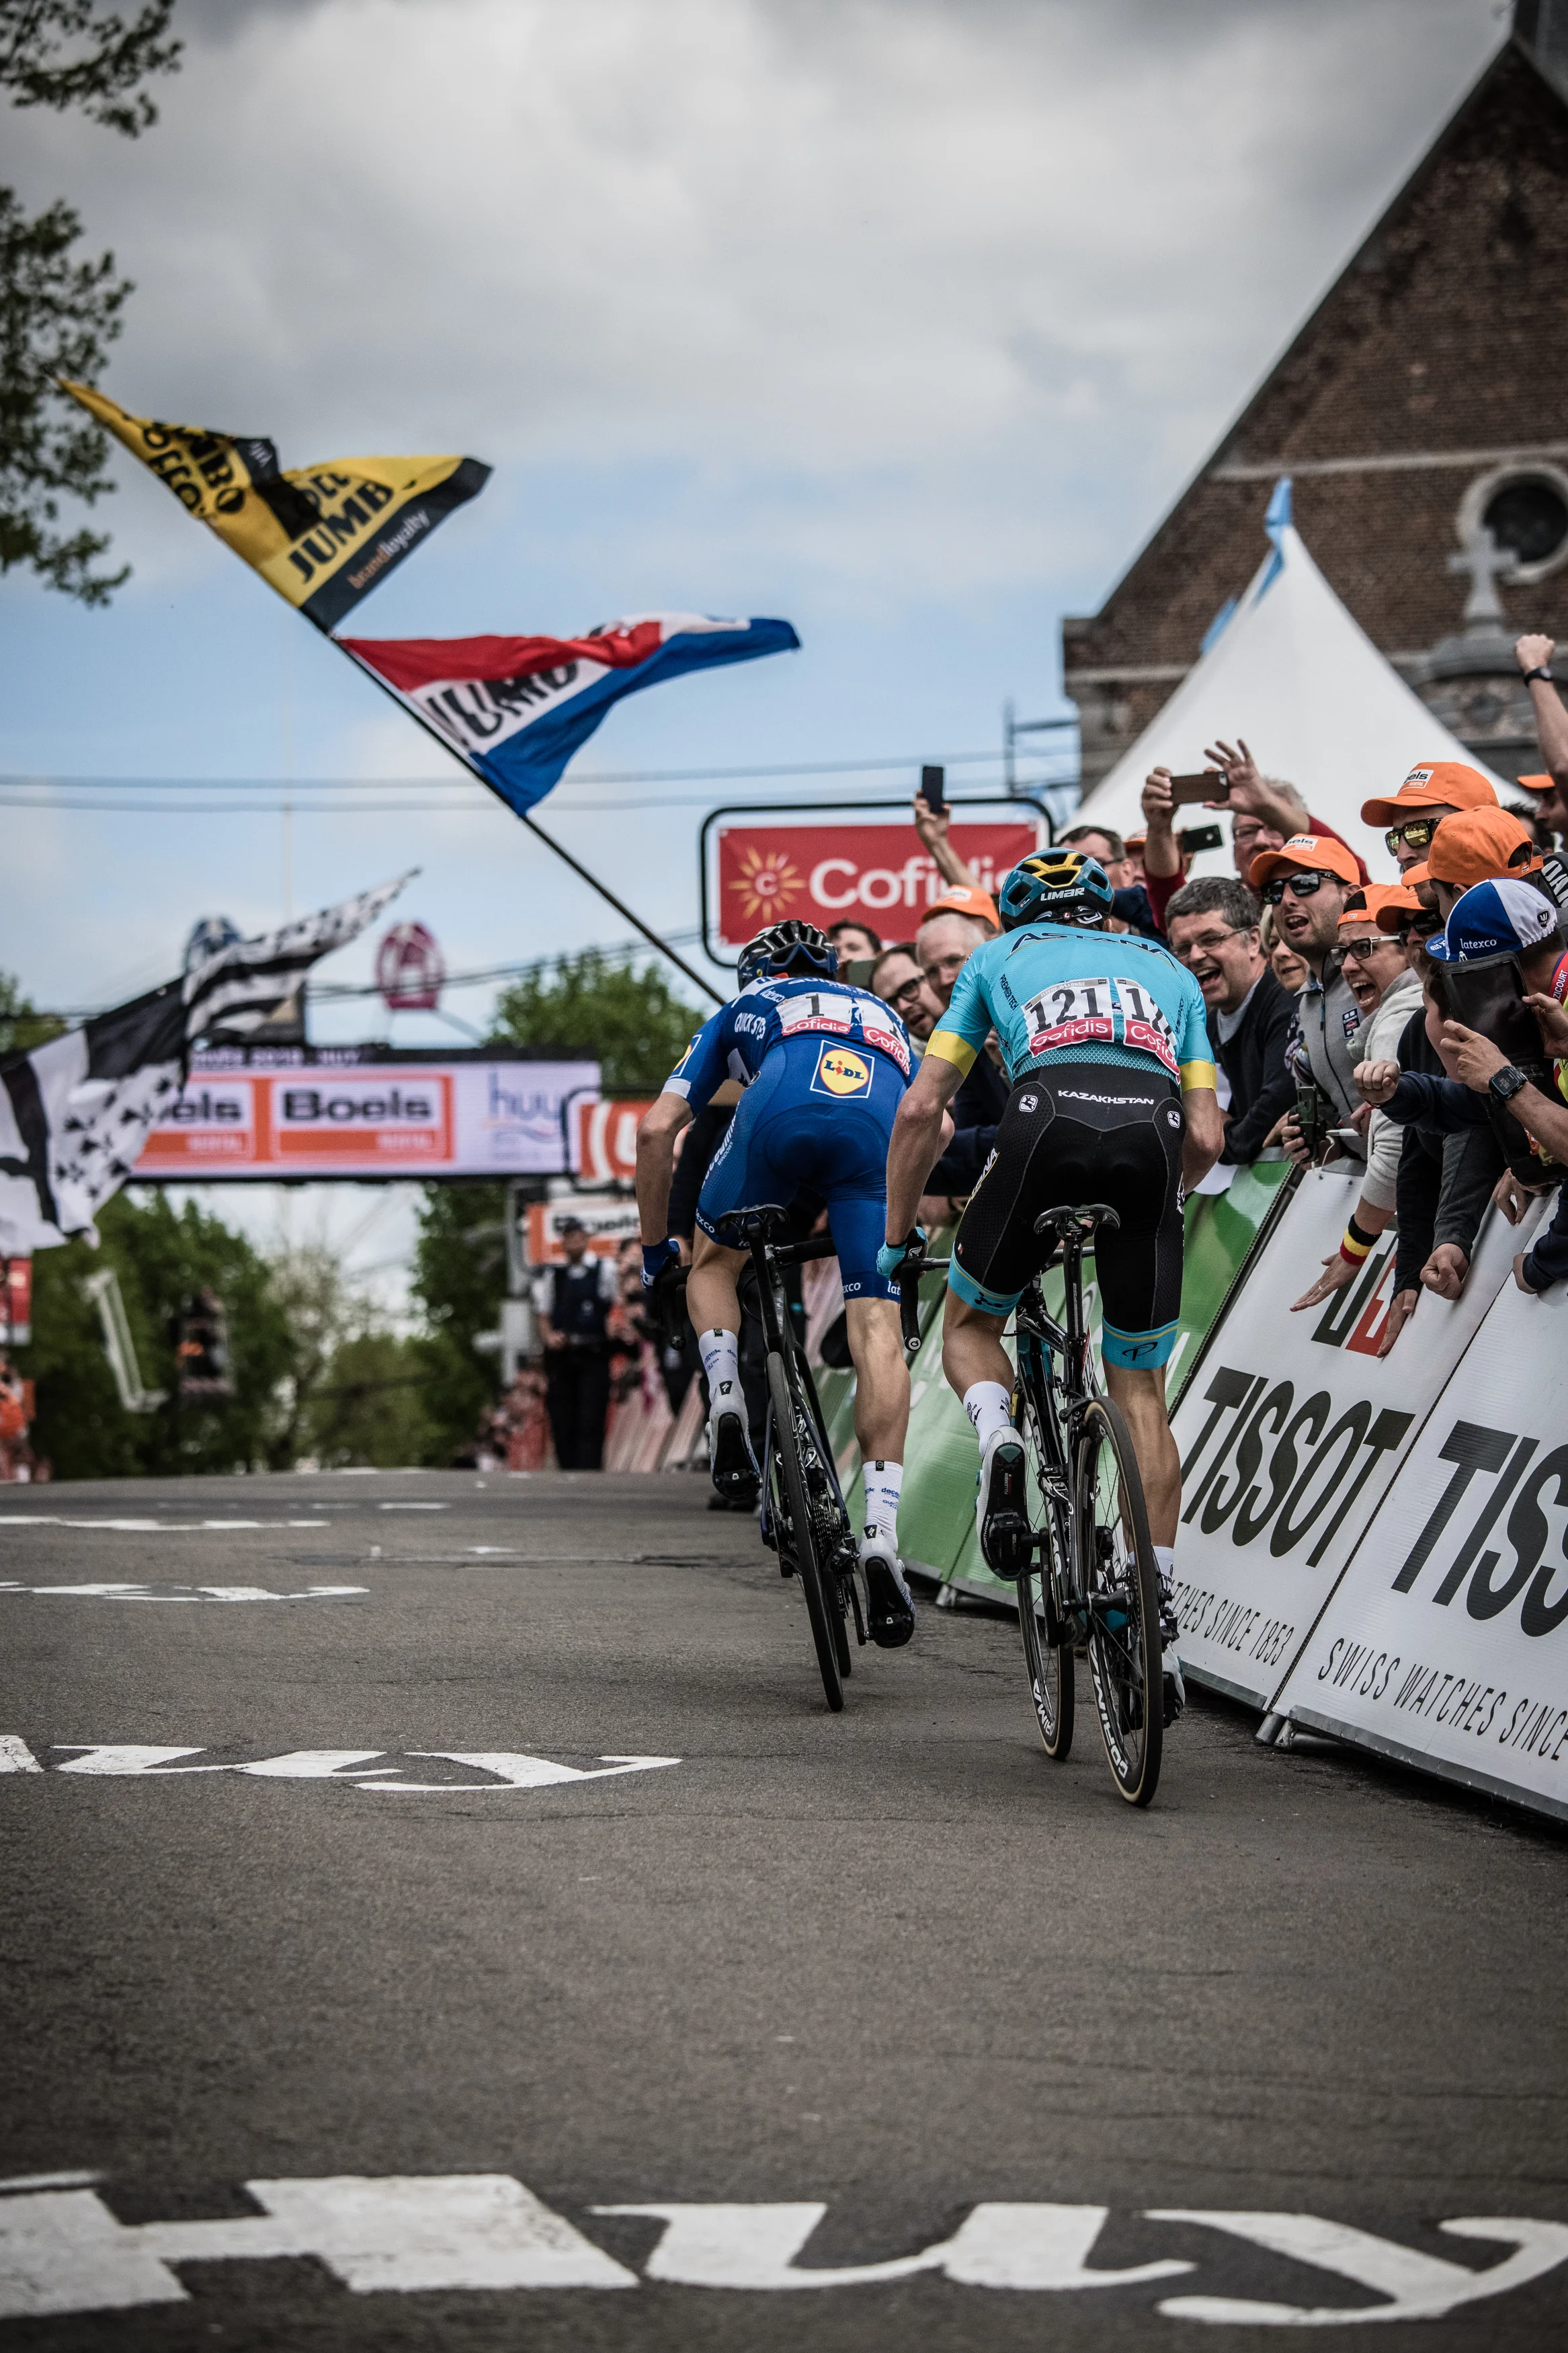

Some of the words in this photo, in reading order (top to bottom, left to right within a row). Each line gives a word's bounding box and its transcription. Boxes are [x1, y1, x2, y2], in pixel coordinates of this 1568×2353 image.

[288, 481, 394, 584] JUMB
[1460, 938, 1497, 949] latexco
[999, 973, 1012, 1000] PREMIER
[1008, 995, 1019, 1010] TECH
[1553, 969, 1568, 1002] ZICOURT
[806, 993, 825, 1019] 1
[1030, 988, 1104, 1035] 121
[1032, 1020, 1109, 1047] Cofidis
[284, 1088, 433, 1123] Boels
[1058, 1090, 1154, 1105] KAZAKHSTAN
[1181, 1365, 1416, 1568] TISSOT
[1204, 1599, 1261, 1652] SINCE
[1249, 1618, 1295, 1667] 1853
[1317, 1638, 1401, 1700] SWISS
[1393, 1663, 1507, 1736] WATCHES
[1089, 1634, 1128, 1779] CORIMA
